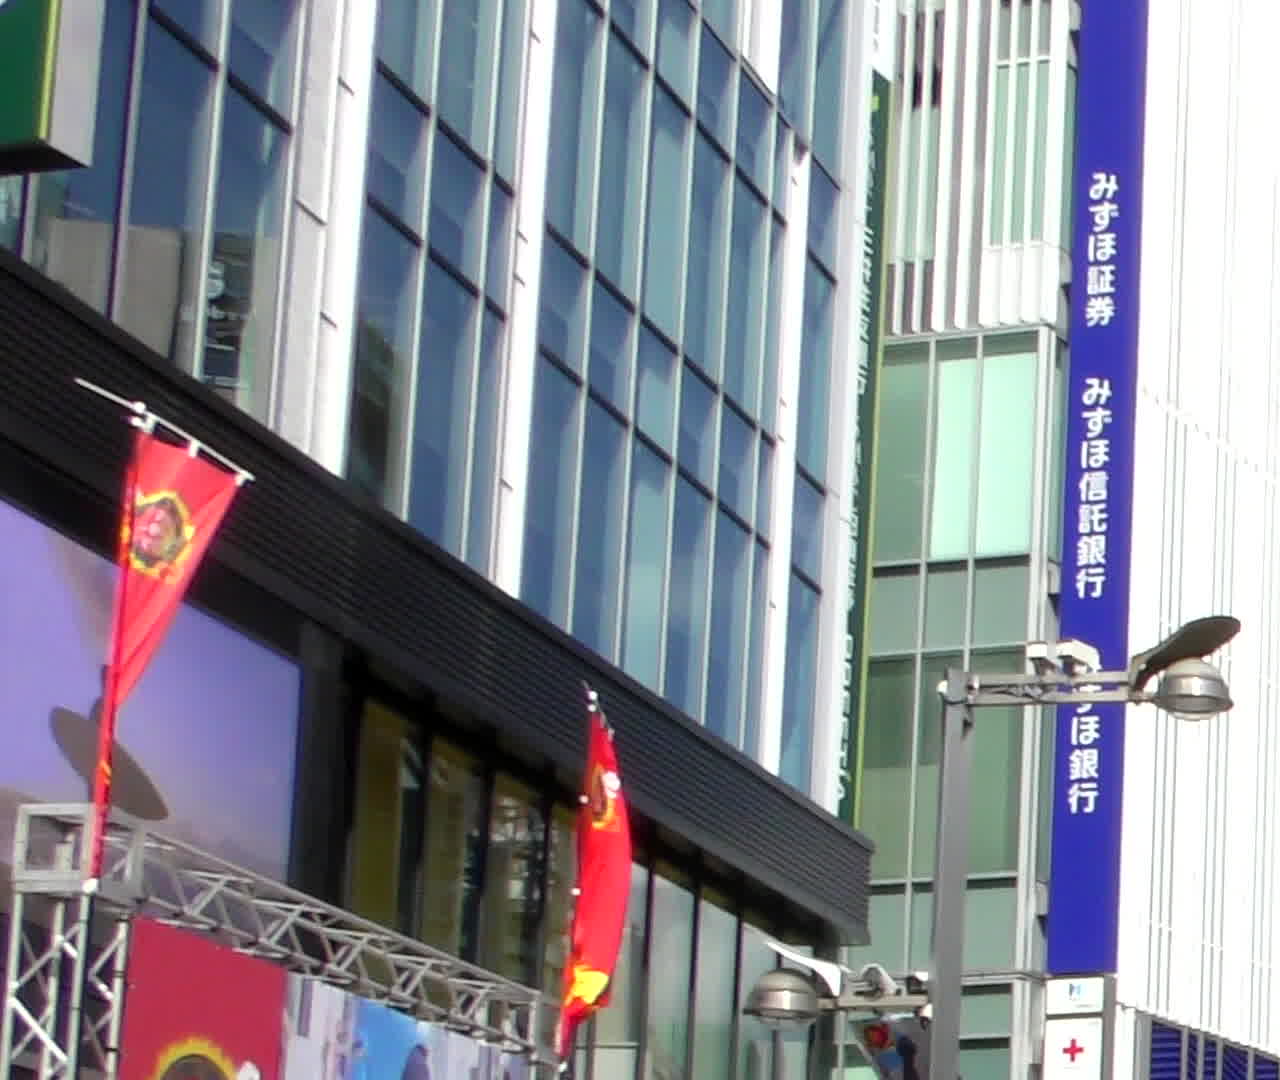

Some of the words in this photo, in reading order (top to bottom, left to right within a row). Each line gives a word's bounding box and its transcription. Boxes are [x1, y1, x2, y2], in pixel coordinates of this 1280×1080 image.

[1085, 172, 1119, 328] みずほ証券
[1075, 377, 1113, 599] みずほ信託銀行
[1068, 650, 1102, 815] ほ銀行
